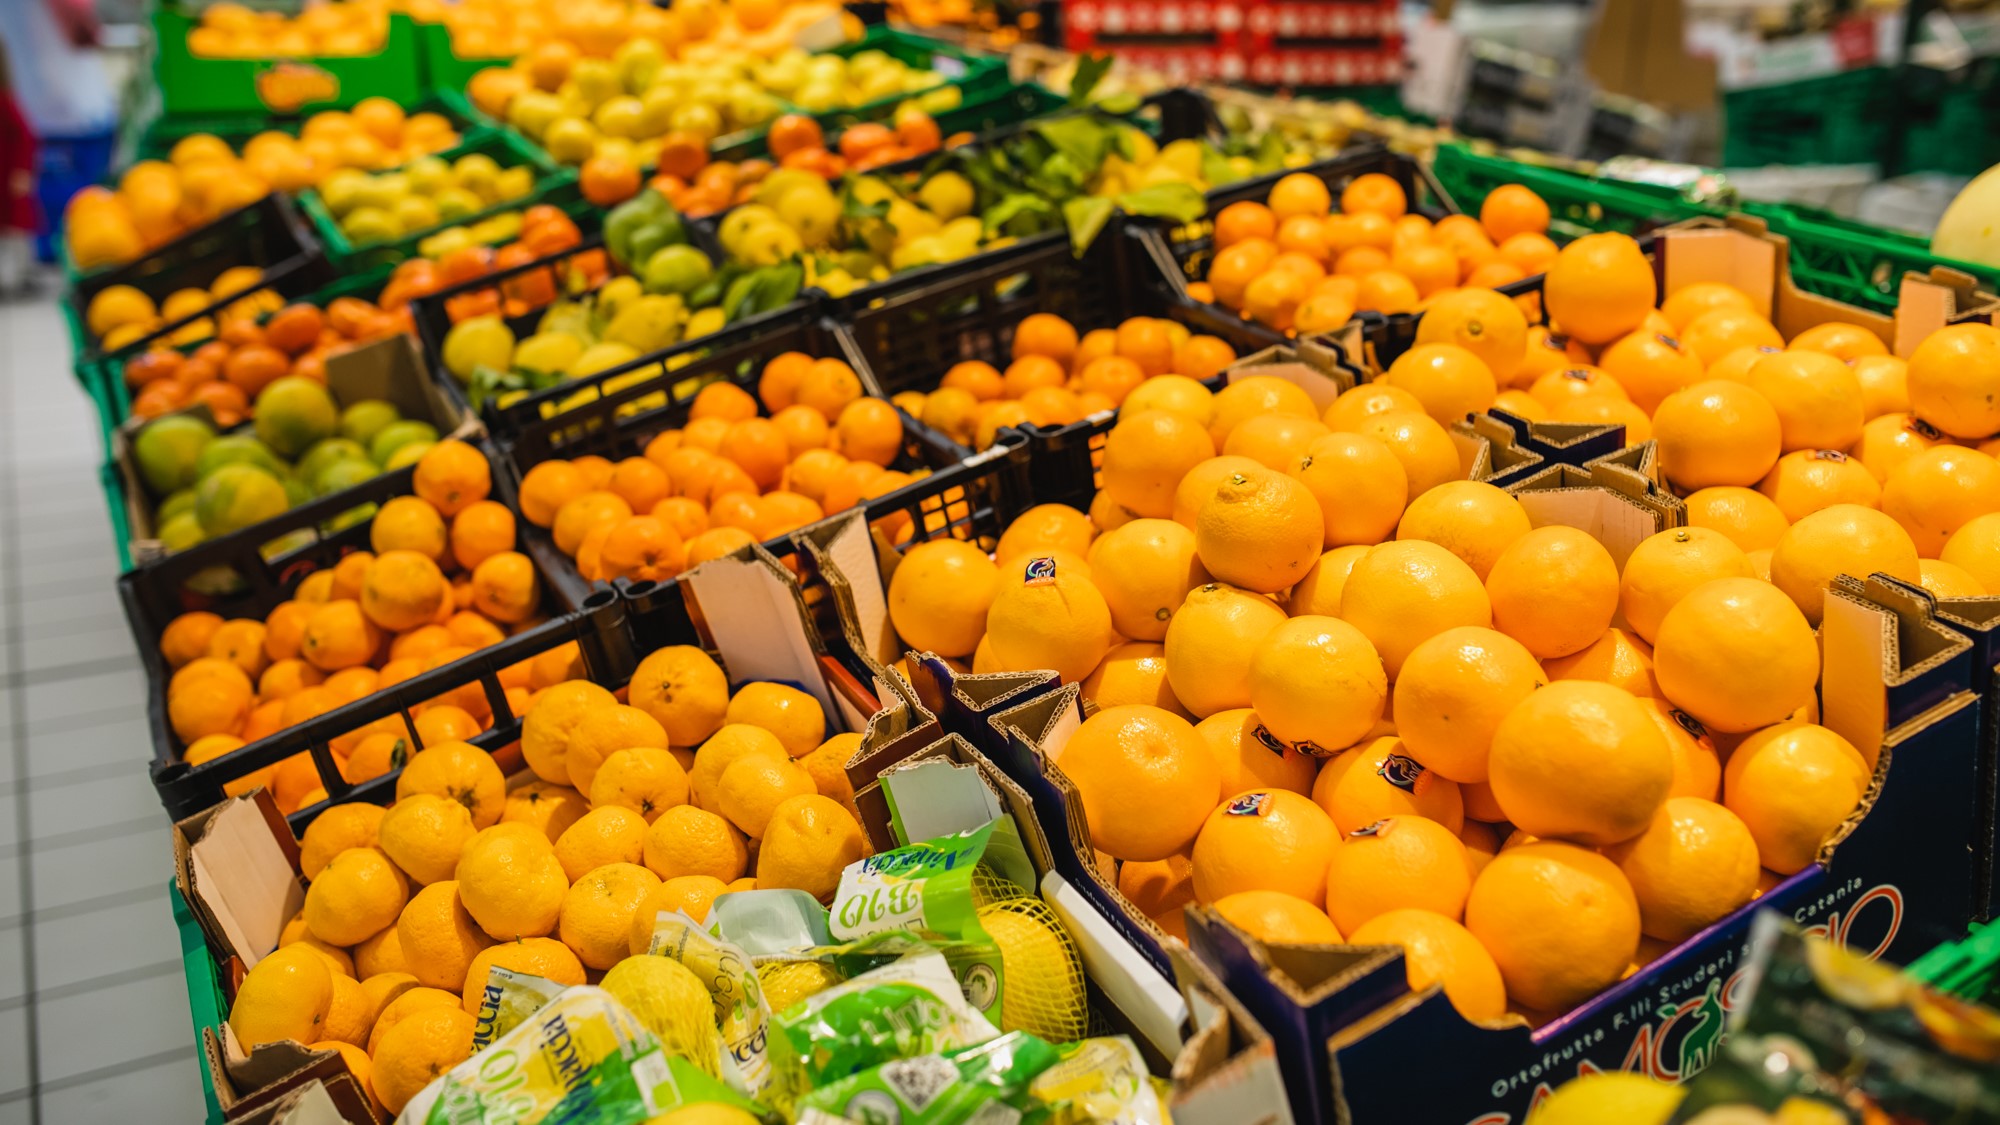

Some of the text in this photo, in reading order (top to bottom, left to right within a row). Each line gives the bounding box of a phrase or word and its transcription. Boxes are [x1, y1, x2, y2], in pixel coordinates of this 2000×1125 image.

[839, 881, 919, 929] BIO
[1491, 1028, 1605, 1098] Ortofrutta
[1659, 949, 1734, 1003] Scuderi
[1794, 877, 1863, 924] Catania
